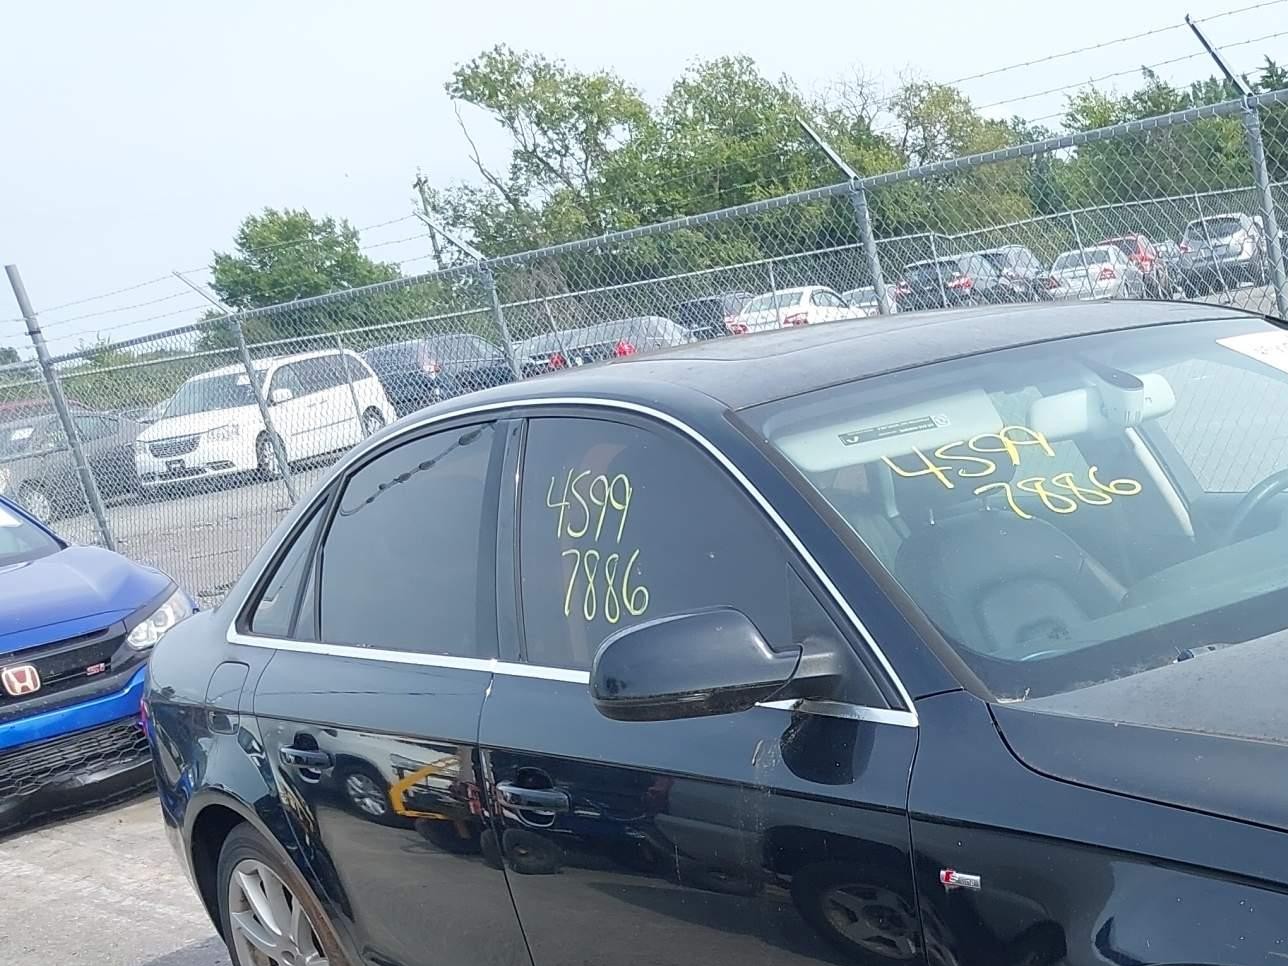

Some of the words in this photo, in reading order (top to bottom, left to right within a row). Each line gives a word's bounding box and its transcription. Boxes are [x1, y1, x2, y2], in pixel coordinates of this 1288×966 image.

[880, 425, 1056, 490] 4599
[973, 465, 1142, 520] 7886
[546, 467, 634, 545] 4599
[561, 548, 650, 624] 7886
